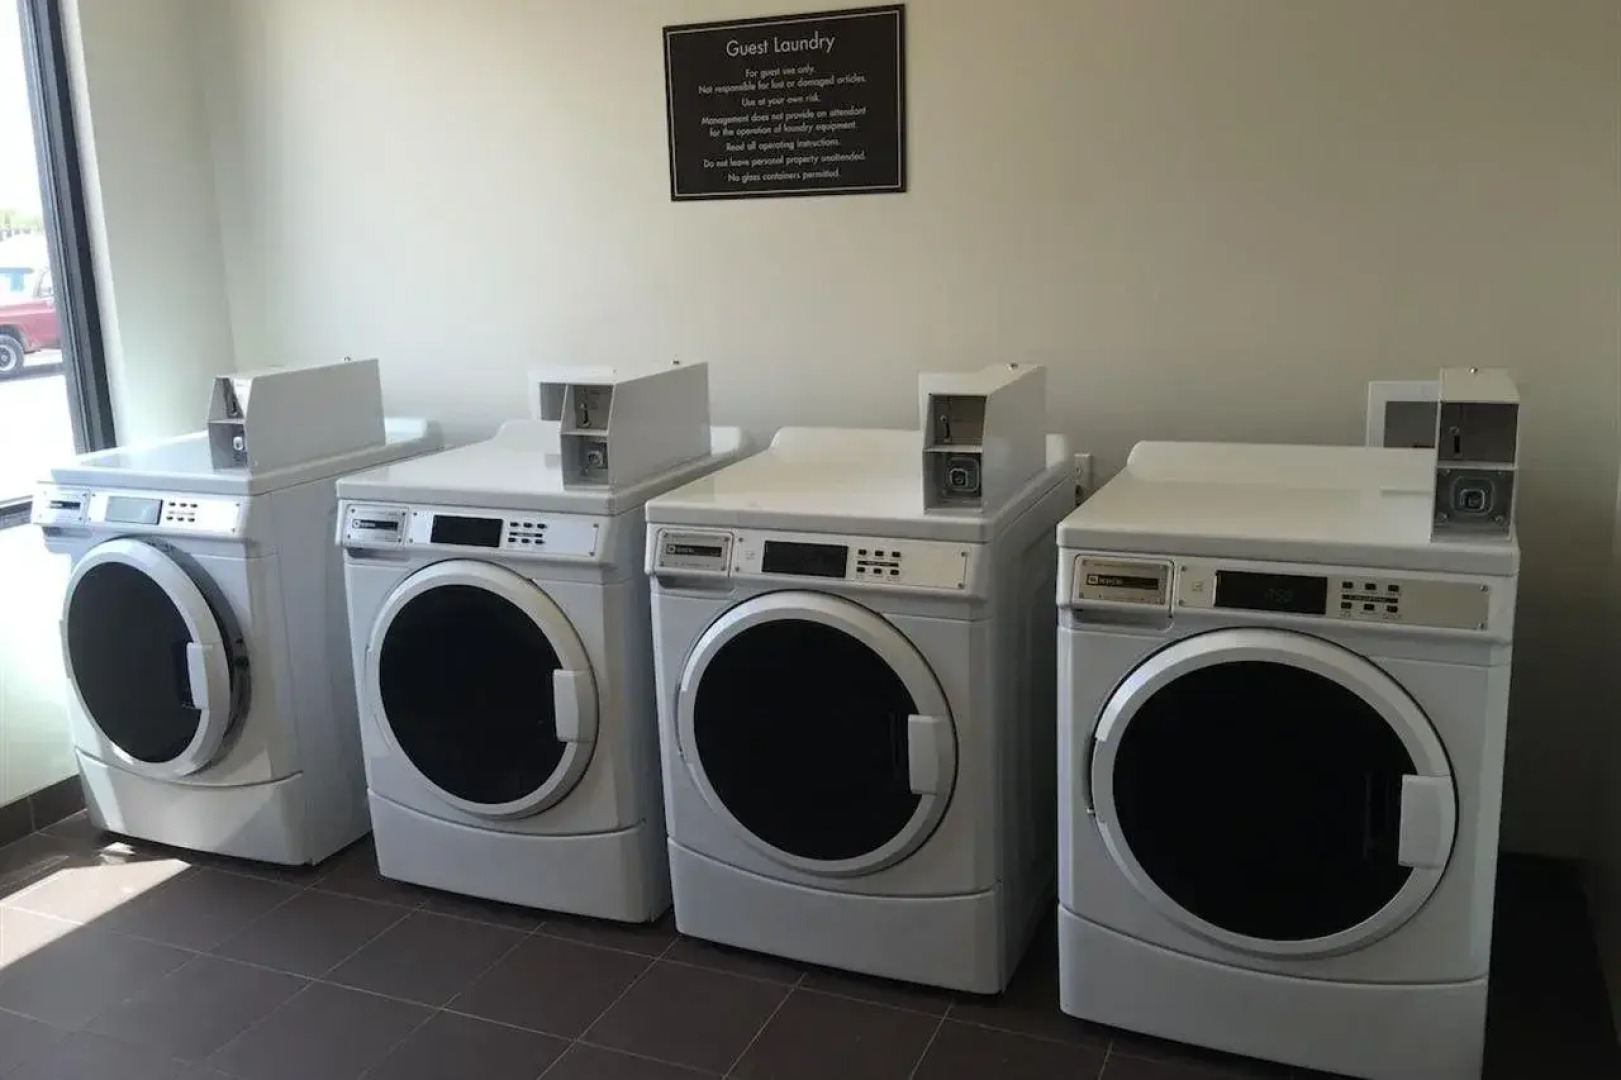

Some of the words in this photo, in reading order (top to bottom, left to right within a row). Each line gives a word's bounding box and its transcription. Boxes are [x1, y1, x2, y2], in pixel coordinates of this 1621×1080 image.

[726, 40, 768, 56] Guest
[774, 31, 835, 53] Laundry
[760, 68, 780, 78] guest
[699, 85, 713, 94] Not
[714, 81, 756, 94] responsible
[758, 80, 769, 89] for
[771, 79, 784, 88] lost
[797, 75, 834, 87] damaged
[836, 72, 866, 83] articles.
[742, 97, 755, 107] Use
[758, 96, 765, 106] at
[768, 96, 784, 107] your
[702, 116, 749, 126] Management
[751, 112, 769, 121] does
[771, 112, 784, 120] not
[785, 109, 814, 121] provide
[817, 110, 827, 118] an
[830, 105, 866, 116] attendant
[710, 128, 720, 137] for
[723, 126, 734, 135] the
[736, 127, 771, 136] operation
[774, 123, 782, 133] of
[784, 122, 814, 133] laundry
[726, 142, 745, 151] Read
[747, 141, 756, 150] all
[758, 141, 794, 151] operating
[703, 159, 714, 168] Do
[730, 156, 749, 166] leave
[751, 155, 784, 167] personal
[786, 156, 818, 165] property
[728, 174, 740, 182] No
[742, 173, 760, 184] glass
[762, 171, 800, 180] containers
